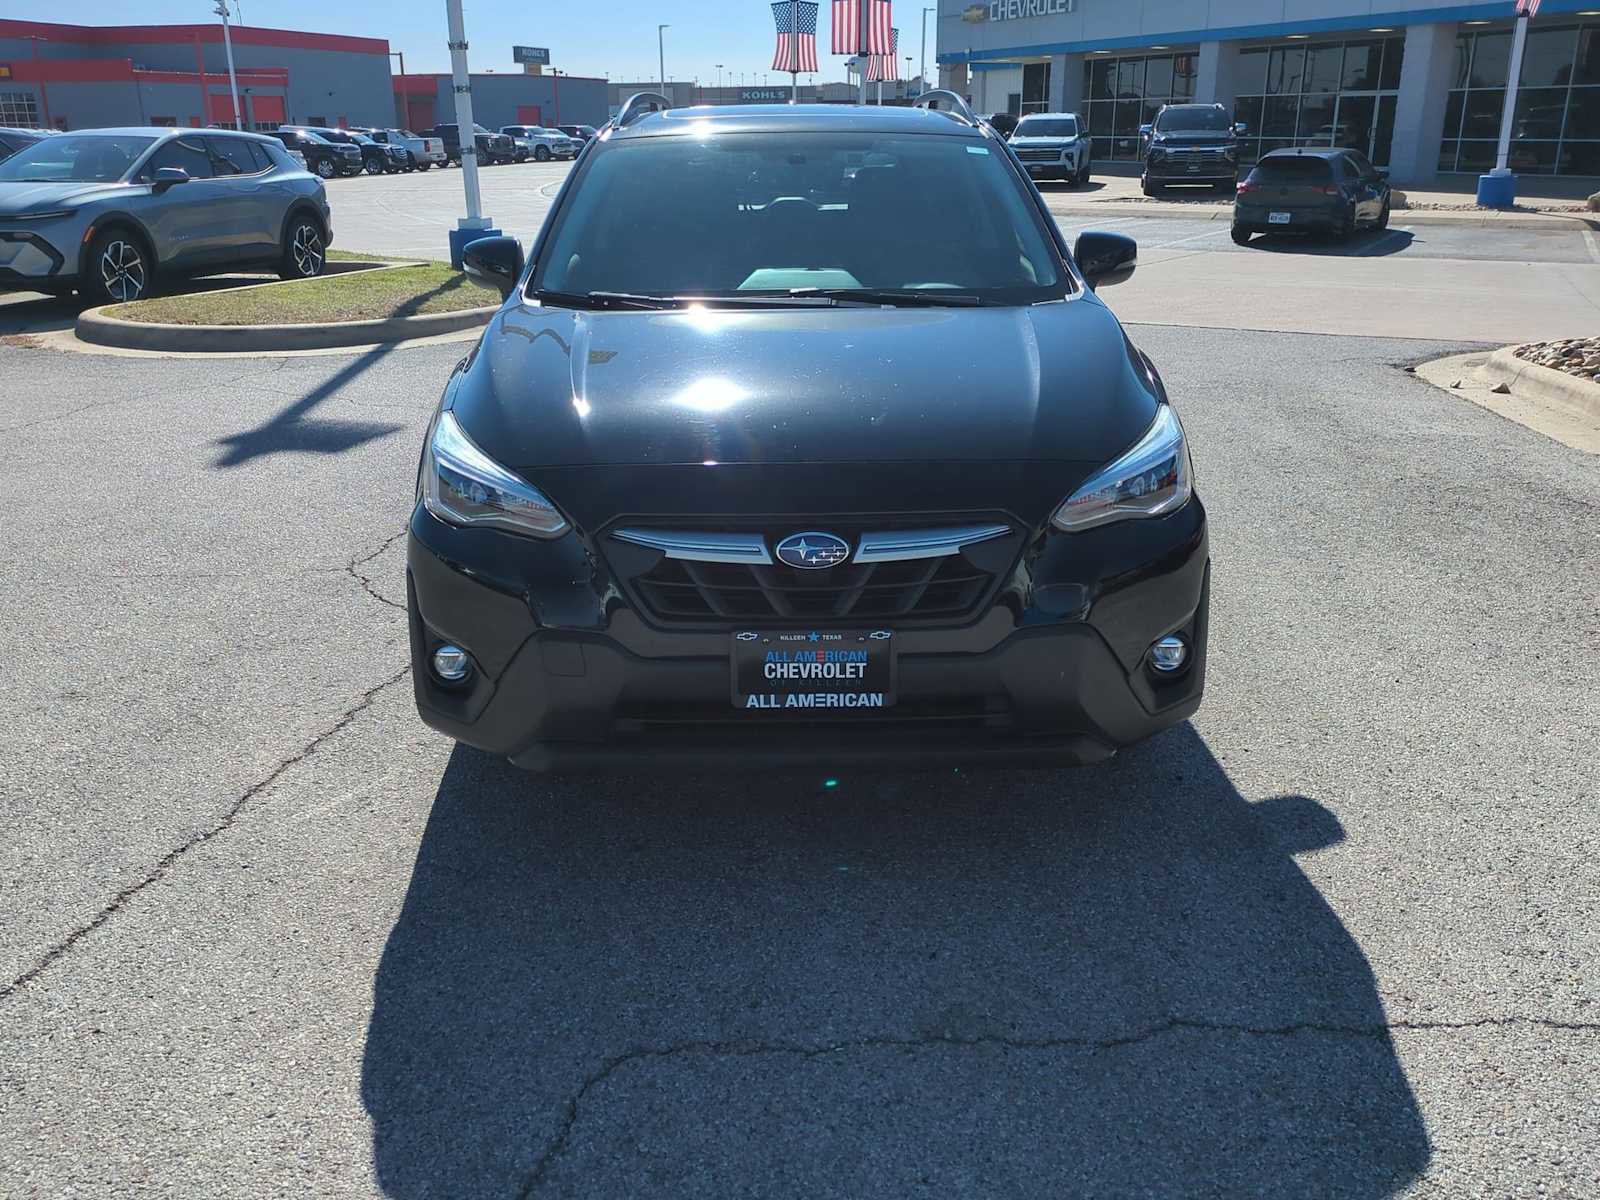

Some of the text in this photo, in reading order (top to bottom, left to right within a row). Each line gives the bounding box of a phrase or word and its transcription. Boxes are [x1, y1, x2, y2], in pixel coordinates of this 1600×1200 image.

[990, 0, 1073, 21] CHEVROLET
[766, 650, 868, 662] ALL AMERICAN
[764, 662, 867, 679] CHEVROLET
[746, 693, 883, 708] ALL AMERICAN
